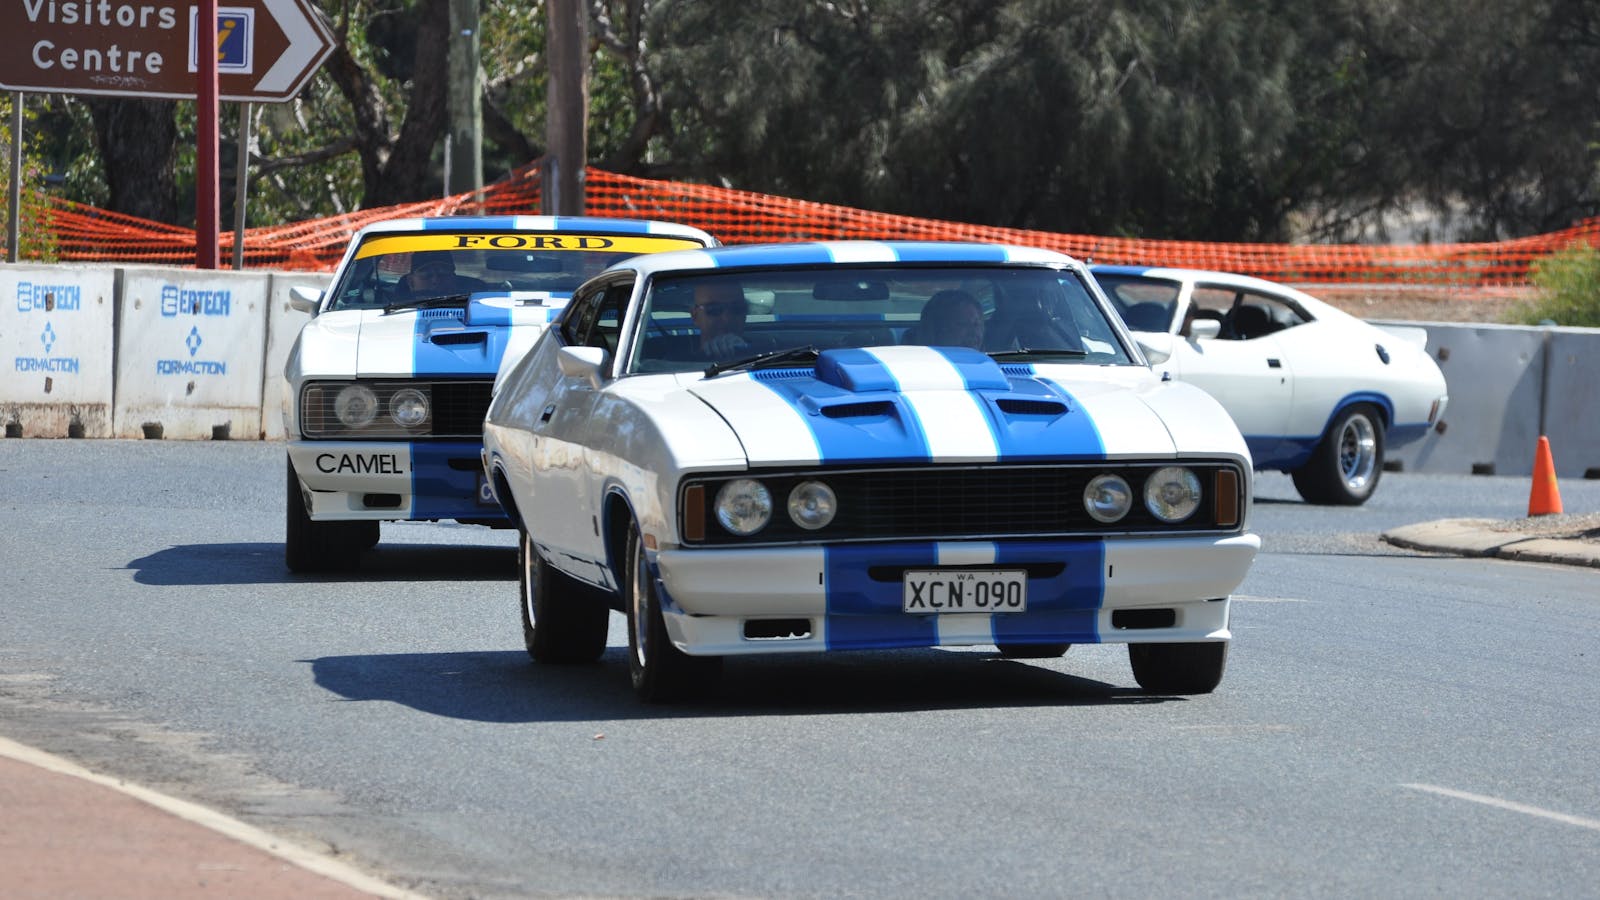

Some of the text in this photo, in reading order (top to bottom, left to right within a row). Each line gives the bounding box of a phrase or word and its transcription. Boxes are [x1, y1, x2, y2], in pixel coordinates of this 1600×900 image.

[23, 0, 176, 29] Visitors
[32, 40, 164, 74] Centre
[453, 236, 613, 248] FORD
[15, 358, 79, 374] FORMACTION
[157, 360, 226, 375] FORMACTION
[316, 453, 403, 474] CAMEL
